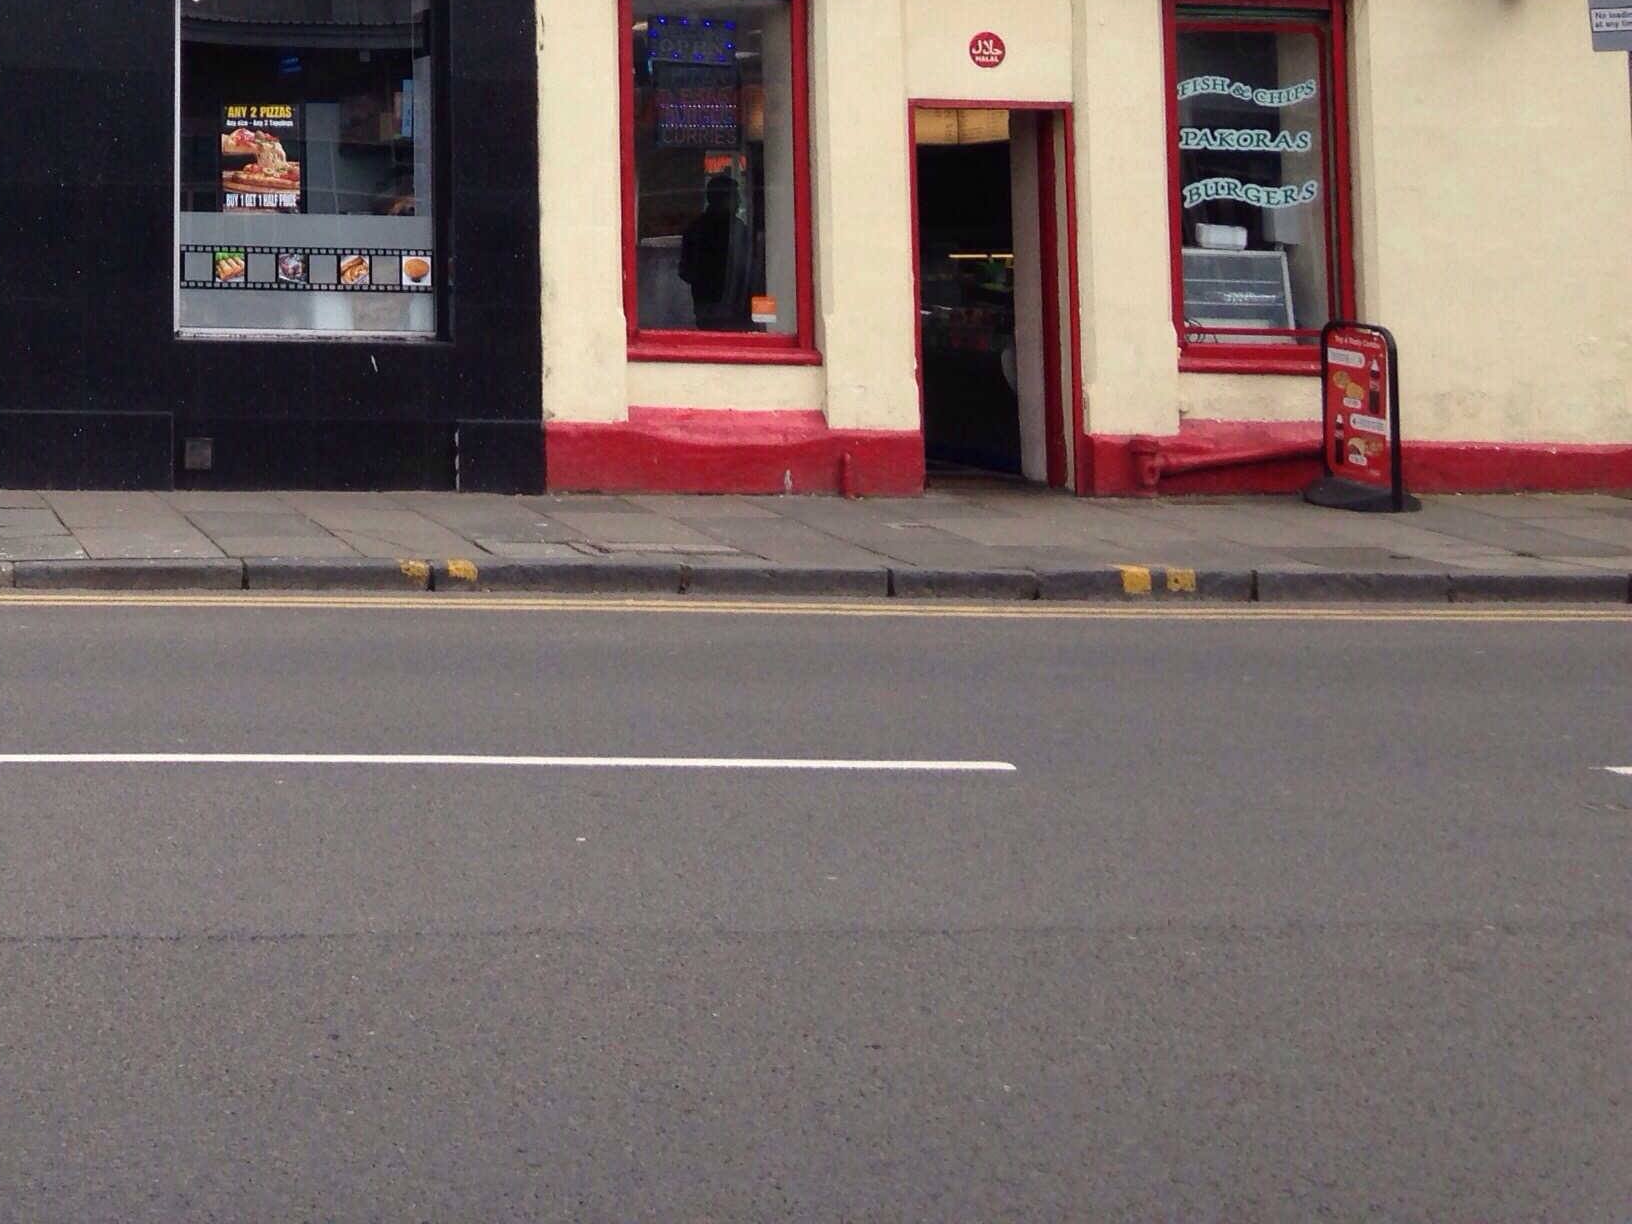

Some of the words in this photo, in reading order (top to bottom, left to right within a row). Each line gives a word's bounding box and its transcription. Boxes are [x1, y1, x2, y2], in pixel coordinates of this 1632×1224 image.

[972, 39, 1003, 55] حلال
[1178, 76, 1230, 100] FISH
[1230, 82, 1252, 100] &
[1253, 80, 1315, 107] CHIPS
[227, 106, 248, 118] ANY
[250, 106, 257, 118] 2
[259, 106, 292, 118] PIZZAS
[1179, 128, 1311, 152] PAKORAS
[225, 193, 239, 207] BUY
[240, 194, 244, 207] 1
[245, 193, 256, 207] GET
[258, 194, 262, 207] 1
[1183, 178, 1317, 208] BURGERS
